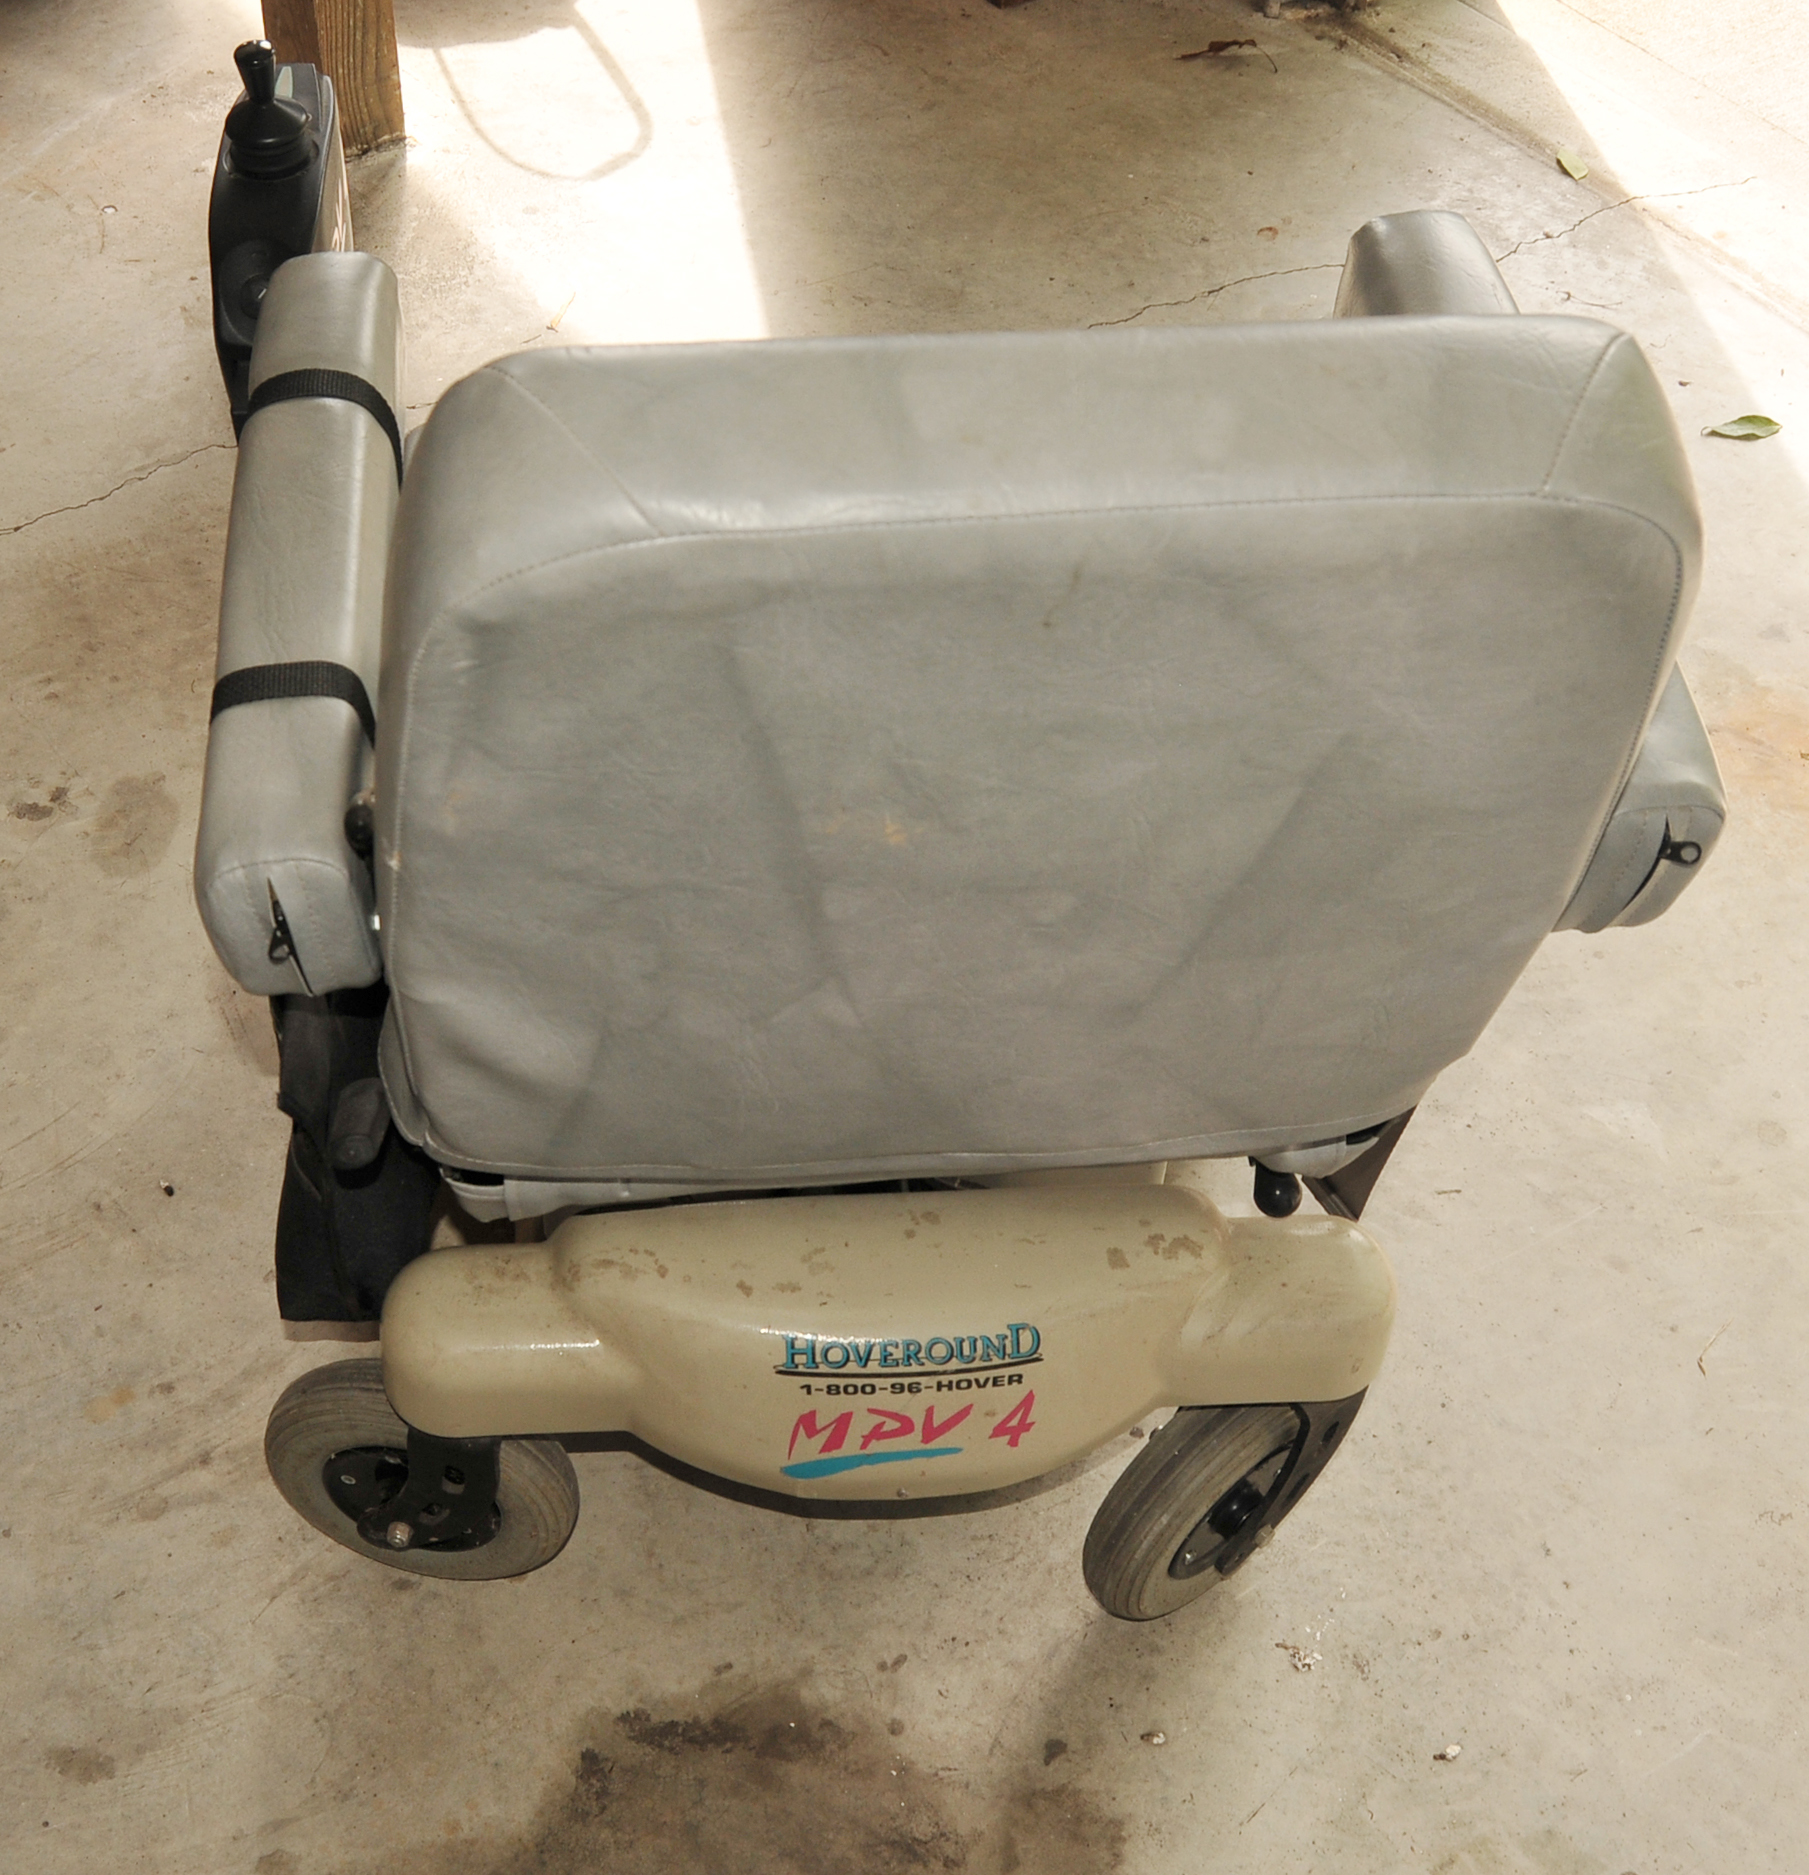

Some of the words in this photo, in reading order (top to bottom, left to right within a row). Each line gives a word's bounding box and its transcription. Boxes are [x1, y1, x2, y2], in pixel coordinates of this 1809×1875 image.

[783, 1322, 1041, 1370] HOVEROUND
[799, 1373, 1024, 1396] 1-800-96-HOVER
[787, 1403, 974, 1460] MPV
[988, 1389, 1036, 1449] 4
